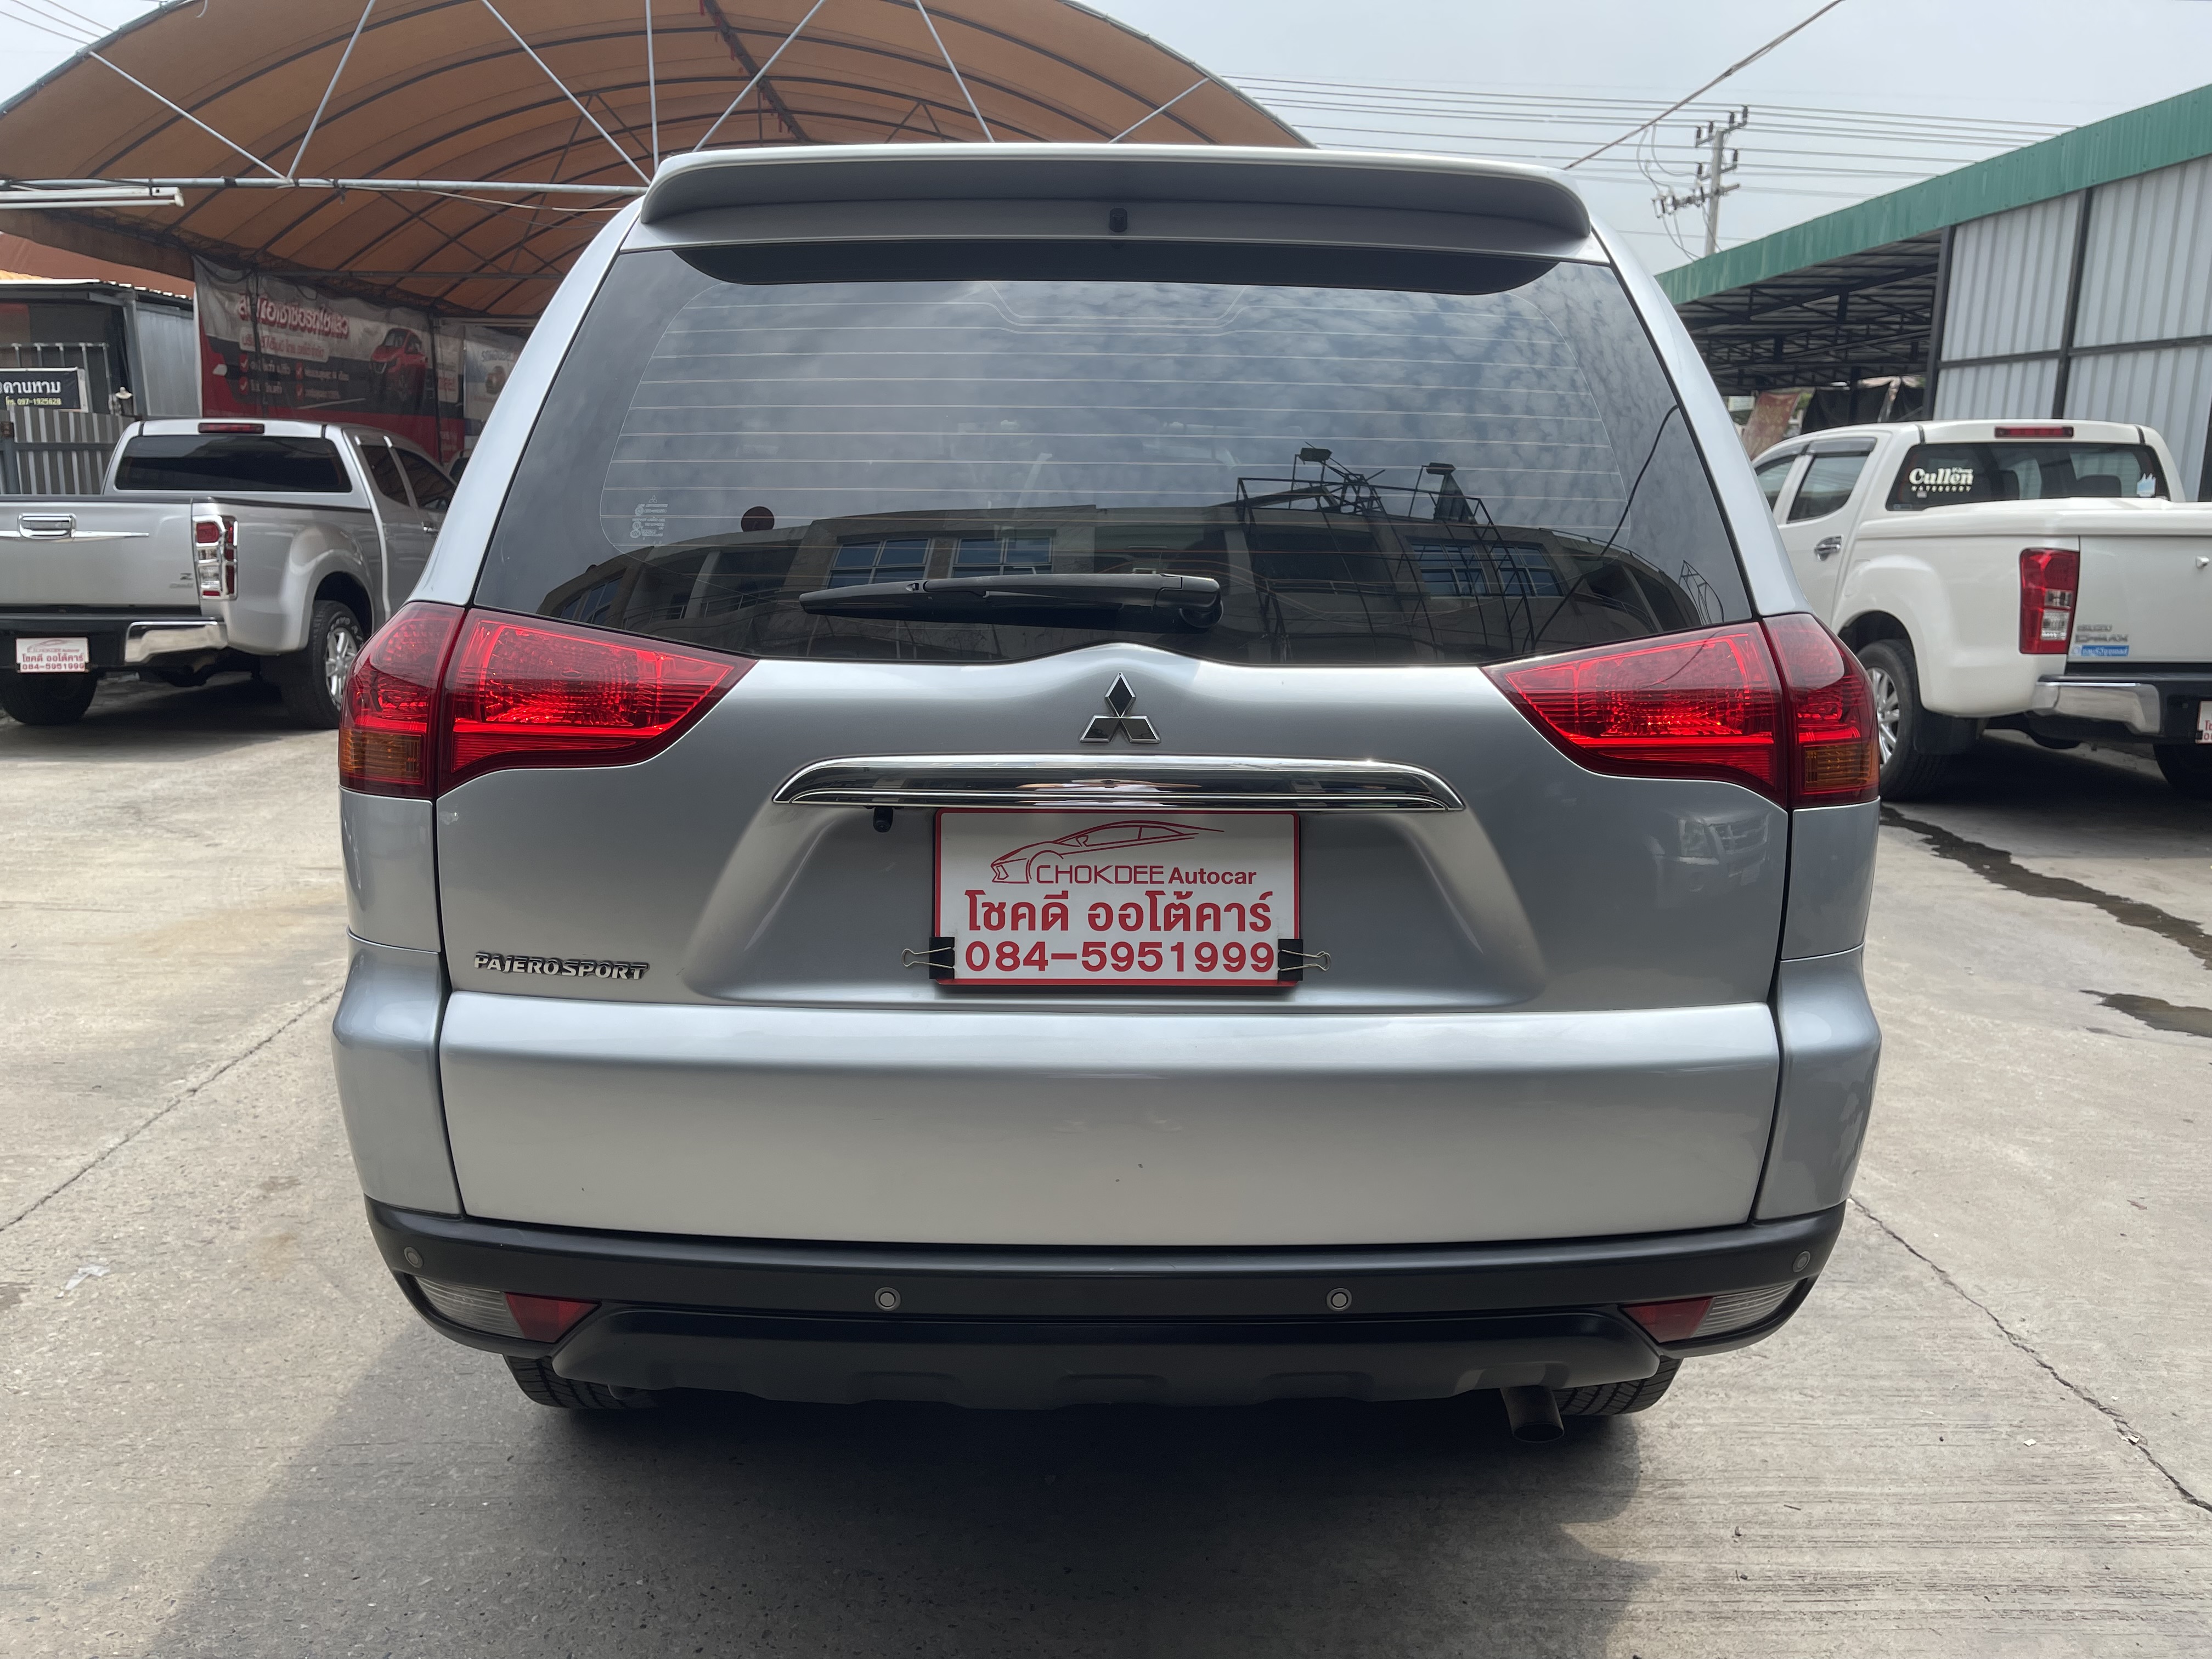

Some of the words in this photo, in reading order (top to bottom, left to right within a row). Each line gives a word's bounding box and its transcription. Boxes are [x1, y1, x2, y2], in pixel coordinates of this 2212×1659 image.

[1909, 468, 1973, 486] Cullen
[1037, 865, 1164, 884] CHOKDEE
[1169, 867, 1256, 884] Autocar
[965, 890, 1069, 931] โชคดี
[1088, 890, 1273, 931] ออโต้คาร์
[966, 941, 1274, 972] 084-5951999
